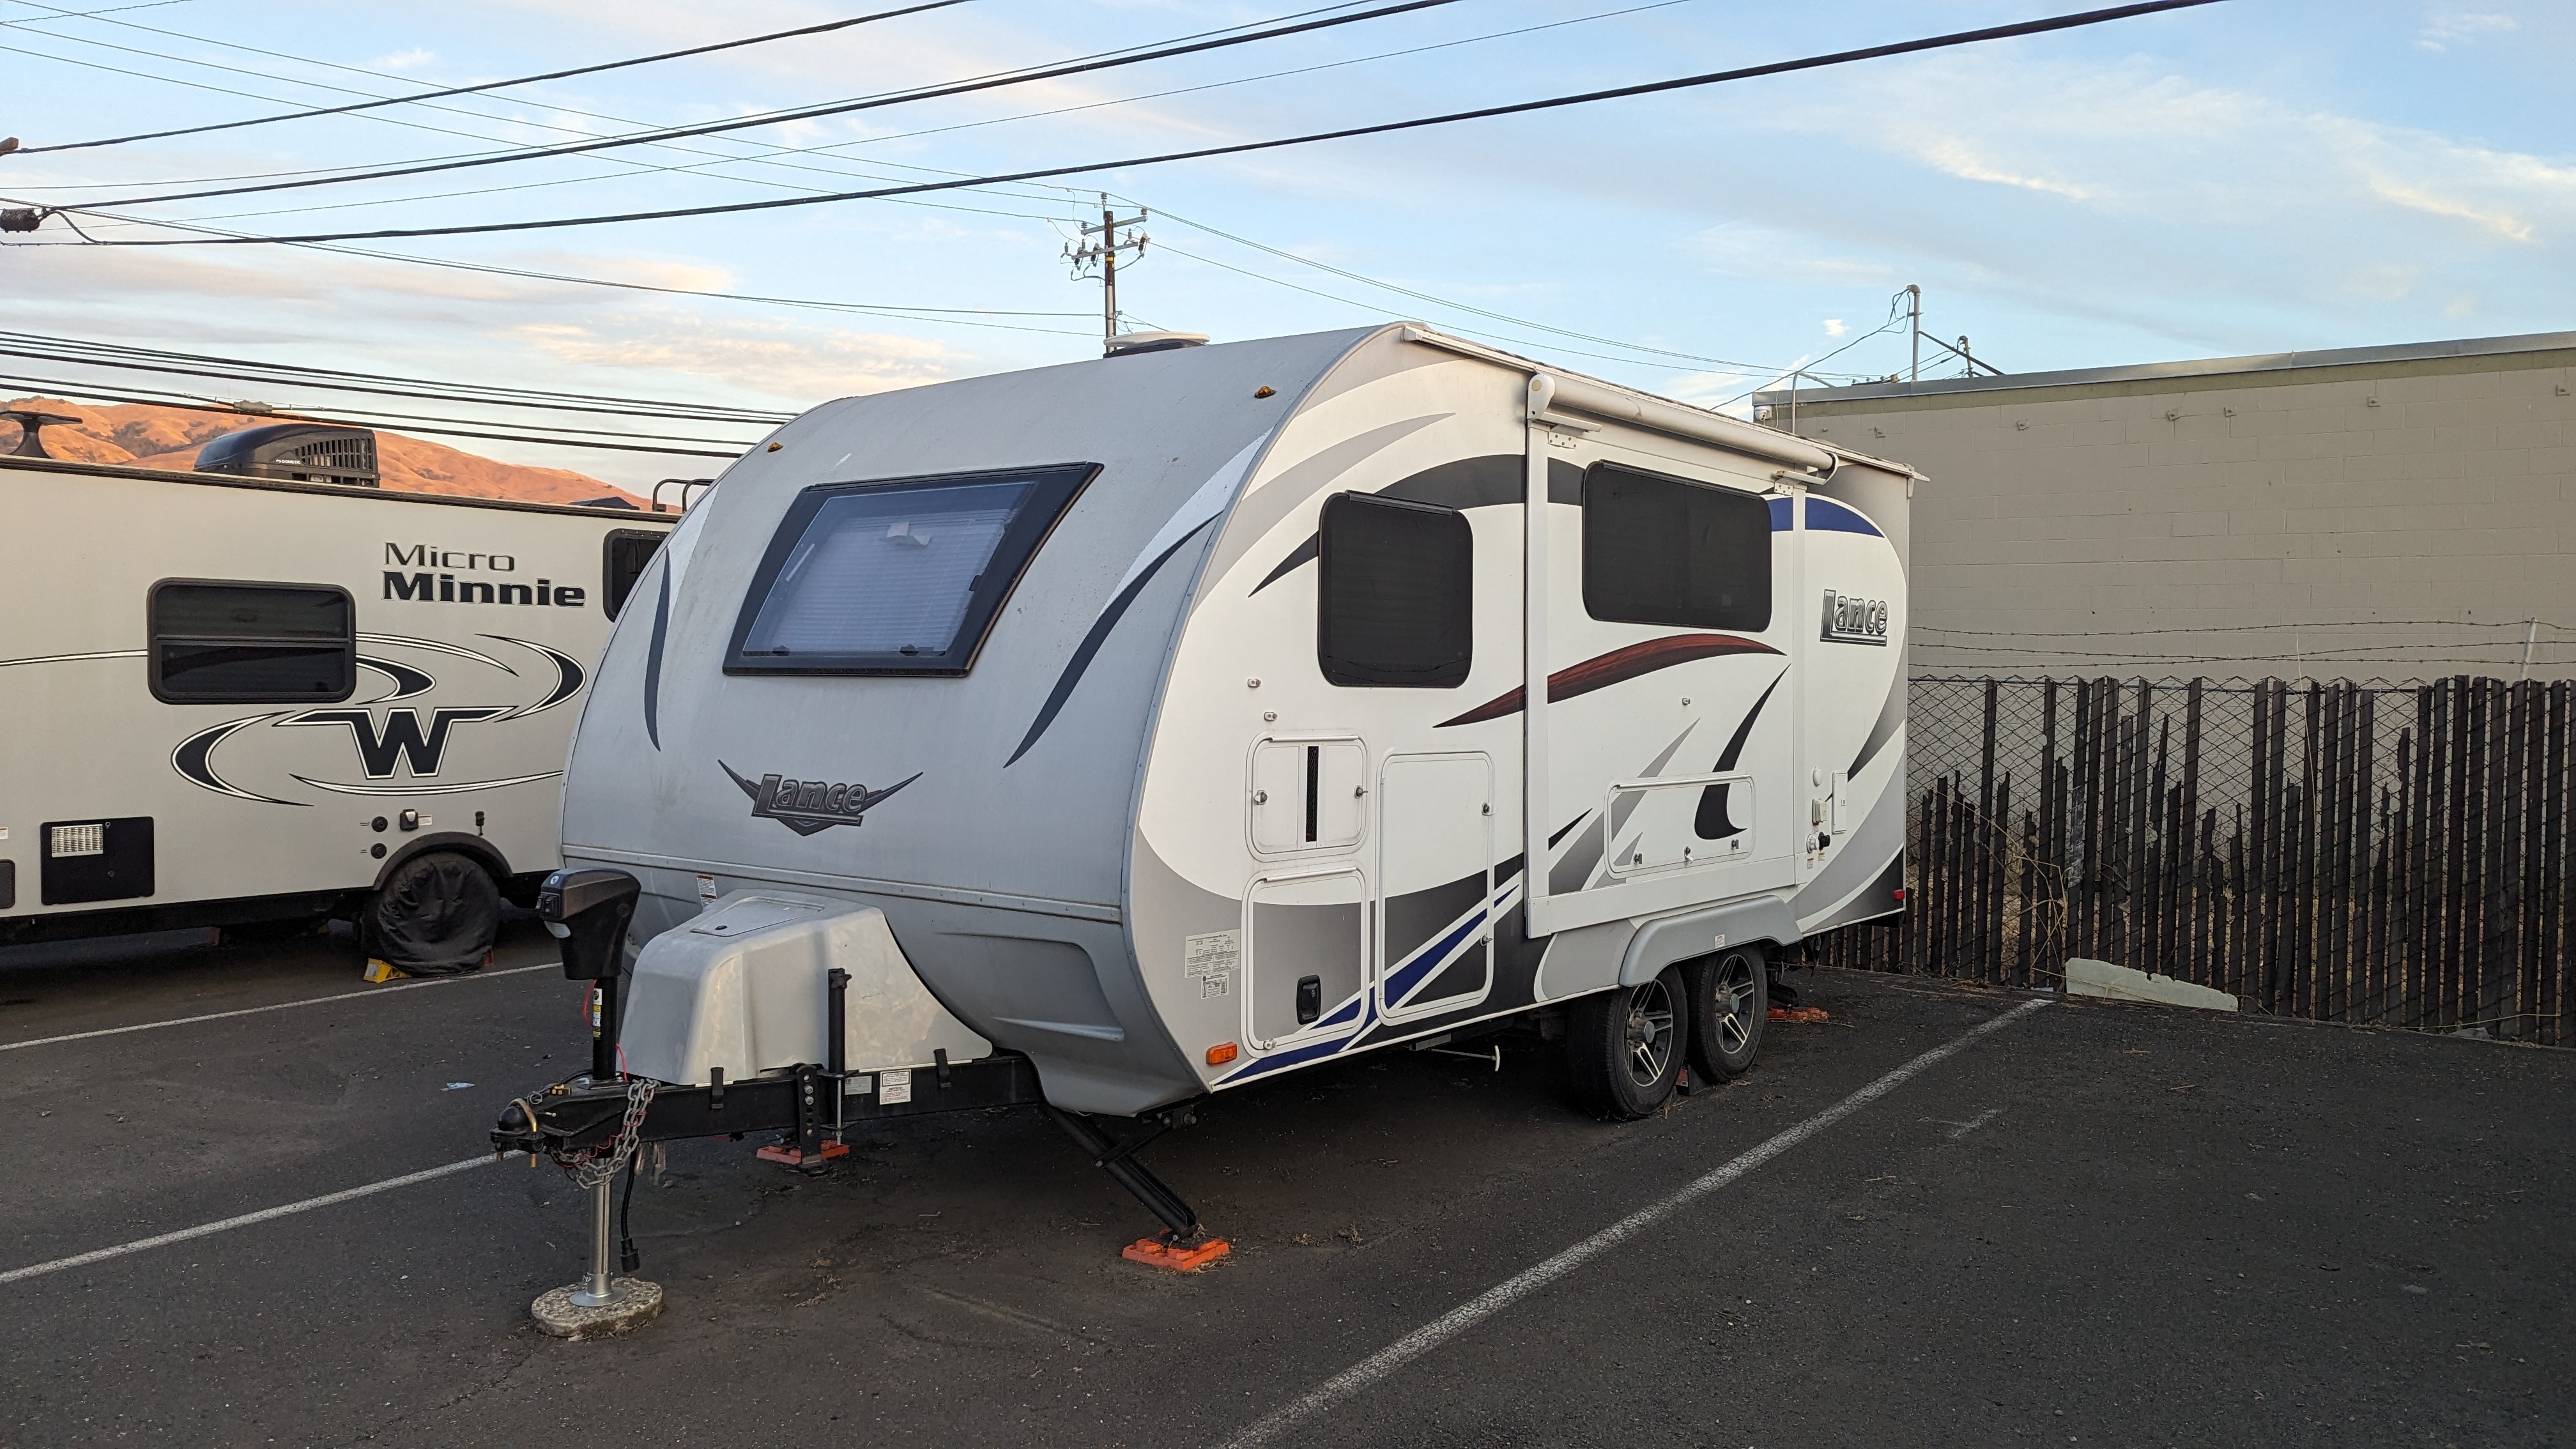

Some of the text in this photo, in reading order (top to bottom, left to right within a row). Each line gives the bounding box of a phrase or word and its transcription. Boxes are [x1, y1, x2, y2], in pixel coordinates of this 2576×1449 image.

[384, 541, 515, 572] Micro
[381, 570, 586, 608] Minnie
[1820, 588, 1888, 647] Lance
[272, 705, 519, 780] W
[751, 773, 868, 827] Lance
